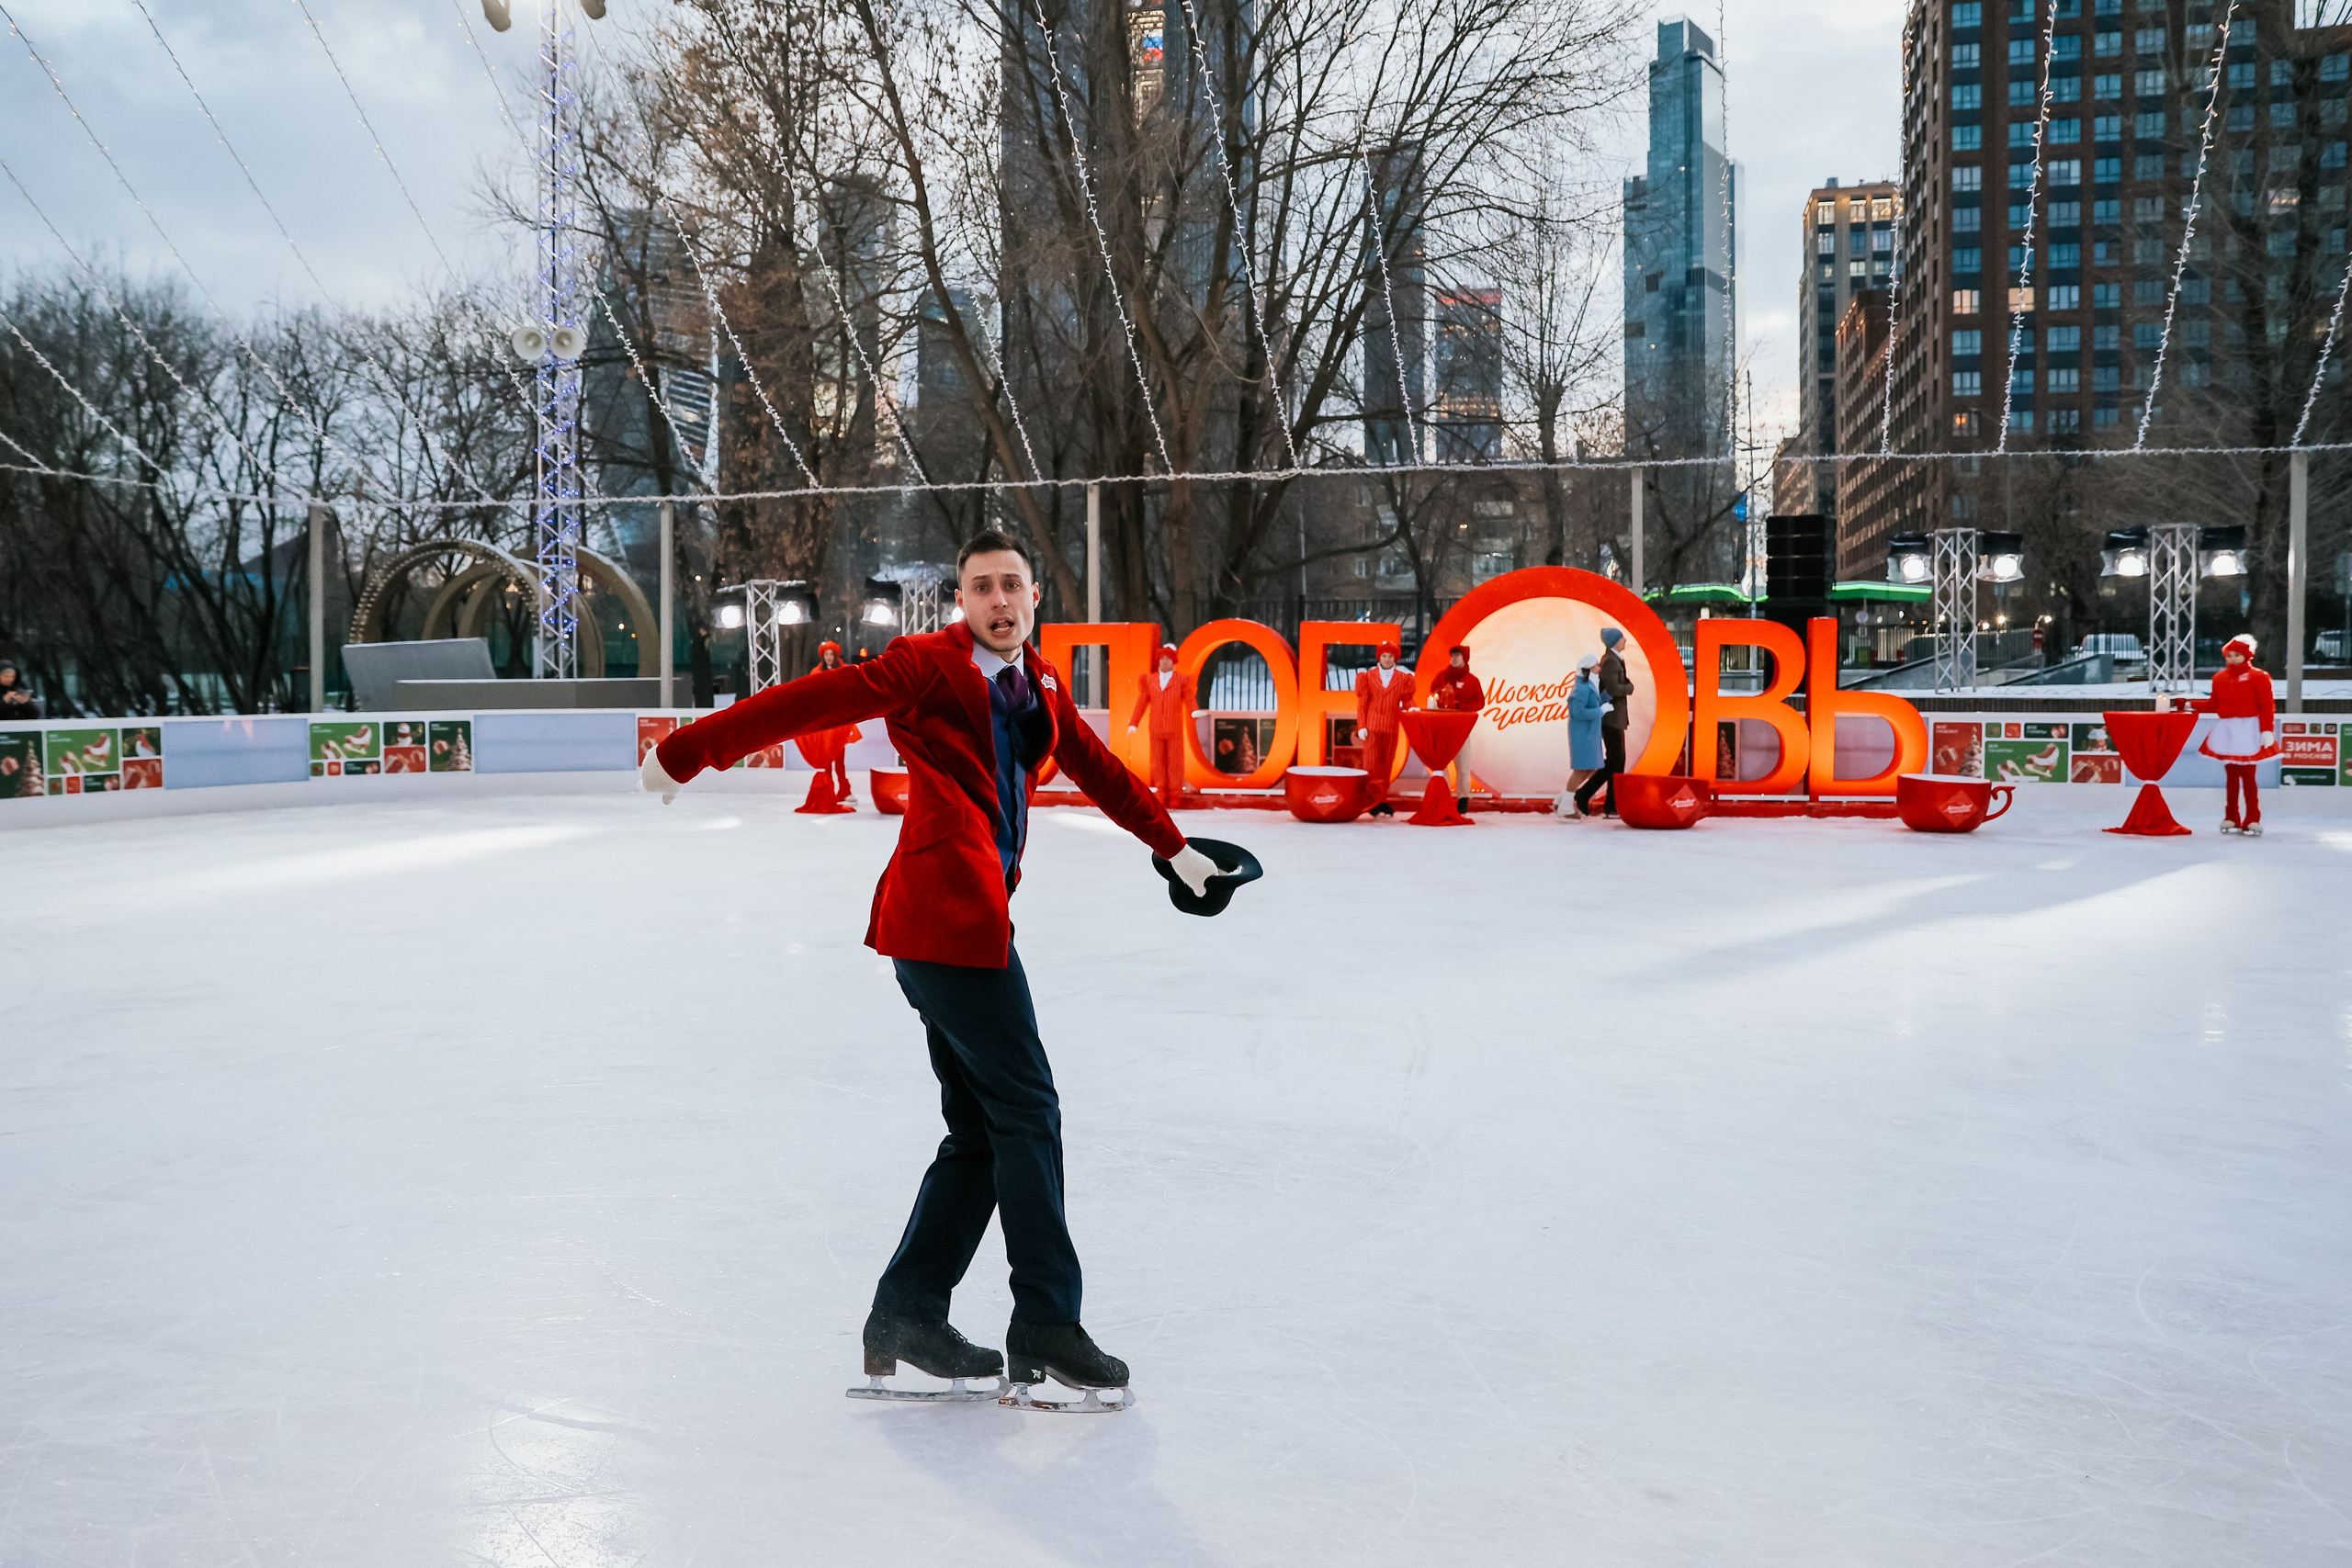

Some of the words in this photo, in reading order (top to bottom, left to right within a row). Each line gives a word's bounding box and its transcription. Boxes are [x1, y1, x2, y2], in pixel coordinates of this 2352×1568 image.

[1483, 671, 1576, 705] Москов
[1483, 702, 1570, 730] чаепи
[2286, 741, 2334, 751] ЗИМА
